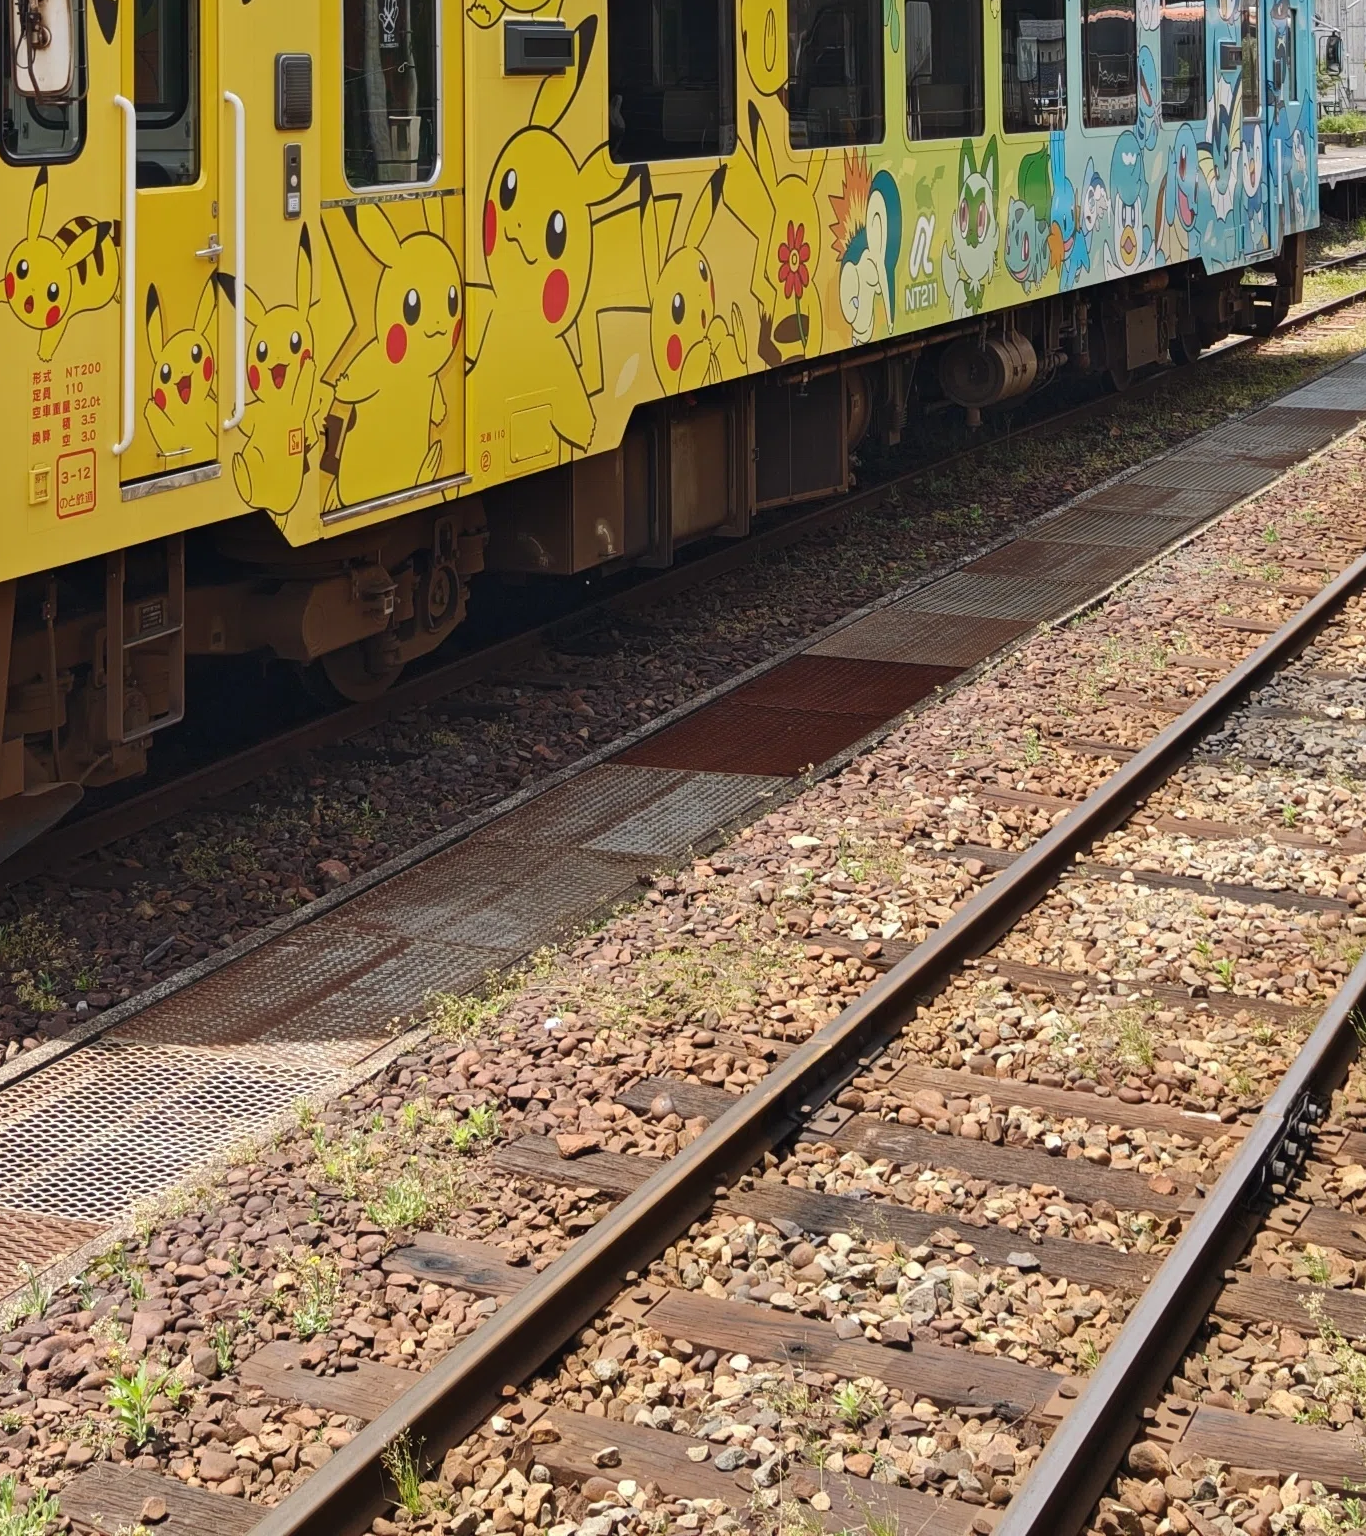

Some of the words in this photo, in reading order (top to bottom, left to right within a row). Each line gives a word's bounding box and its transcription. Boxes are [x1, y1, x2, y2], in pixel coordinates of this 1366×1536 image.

[905, 282, 938, 312] NT211
[32, 370, 52, 385] 形式
[65, 362, 101, 378] NT200
[32, 387, 51, 402] 定員
[65, 382, 83, 395] 110
[74, 396, 101, 410] 32.0t
[81, 413, 96, 425] 3.5
[81, 429, 96, 442] 3.0
[495, 429, 505, 440] 110
[61, 467, 91, 484] 3-12
[60, 491, 94, 509] のと鉄道
